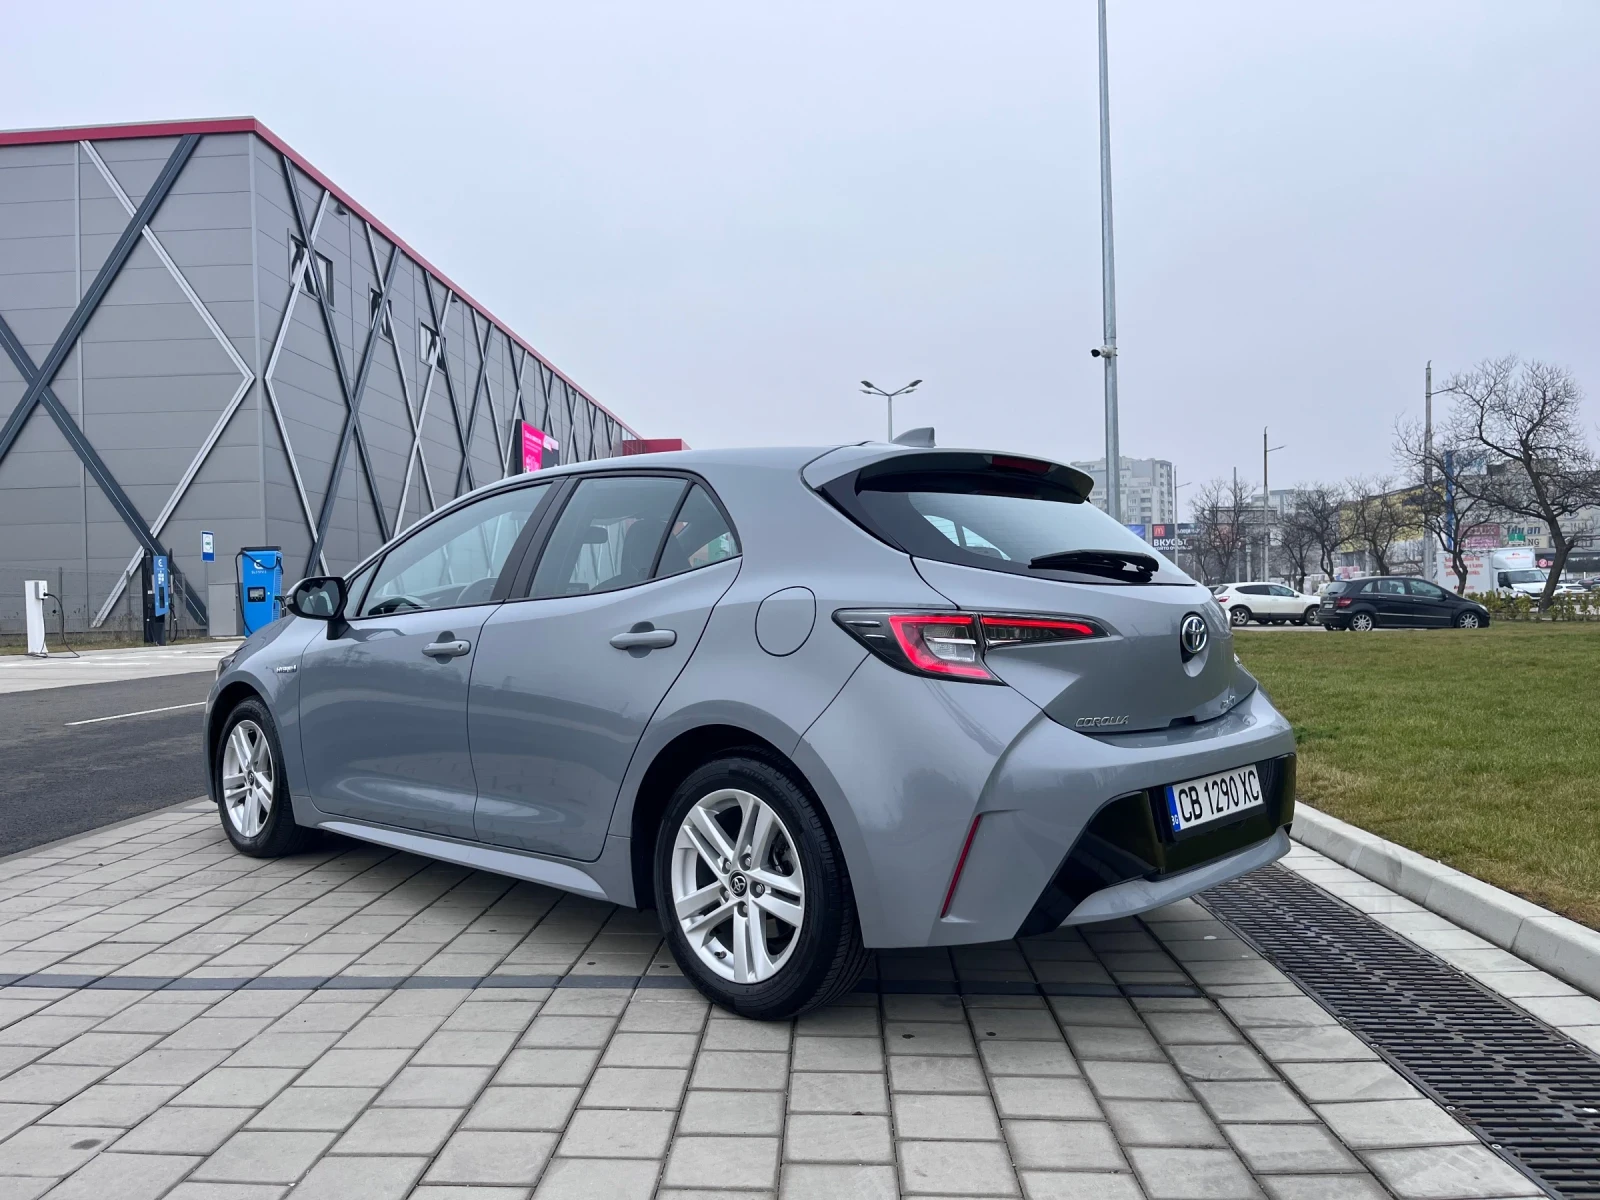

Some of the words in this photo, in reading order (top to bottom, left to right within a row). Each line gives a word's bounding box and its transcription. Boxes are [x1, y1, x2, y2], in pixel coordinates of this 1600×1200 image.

[1075, 715, 1129, 727] COROLLA
[1178, 785, 1203, 823] CB
[1204, 775, 1239, 815] 1290
[1237, 769, 1260, 805] XC
